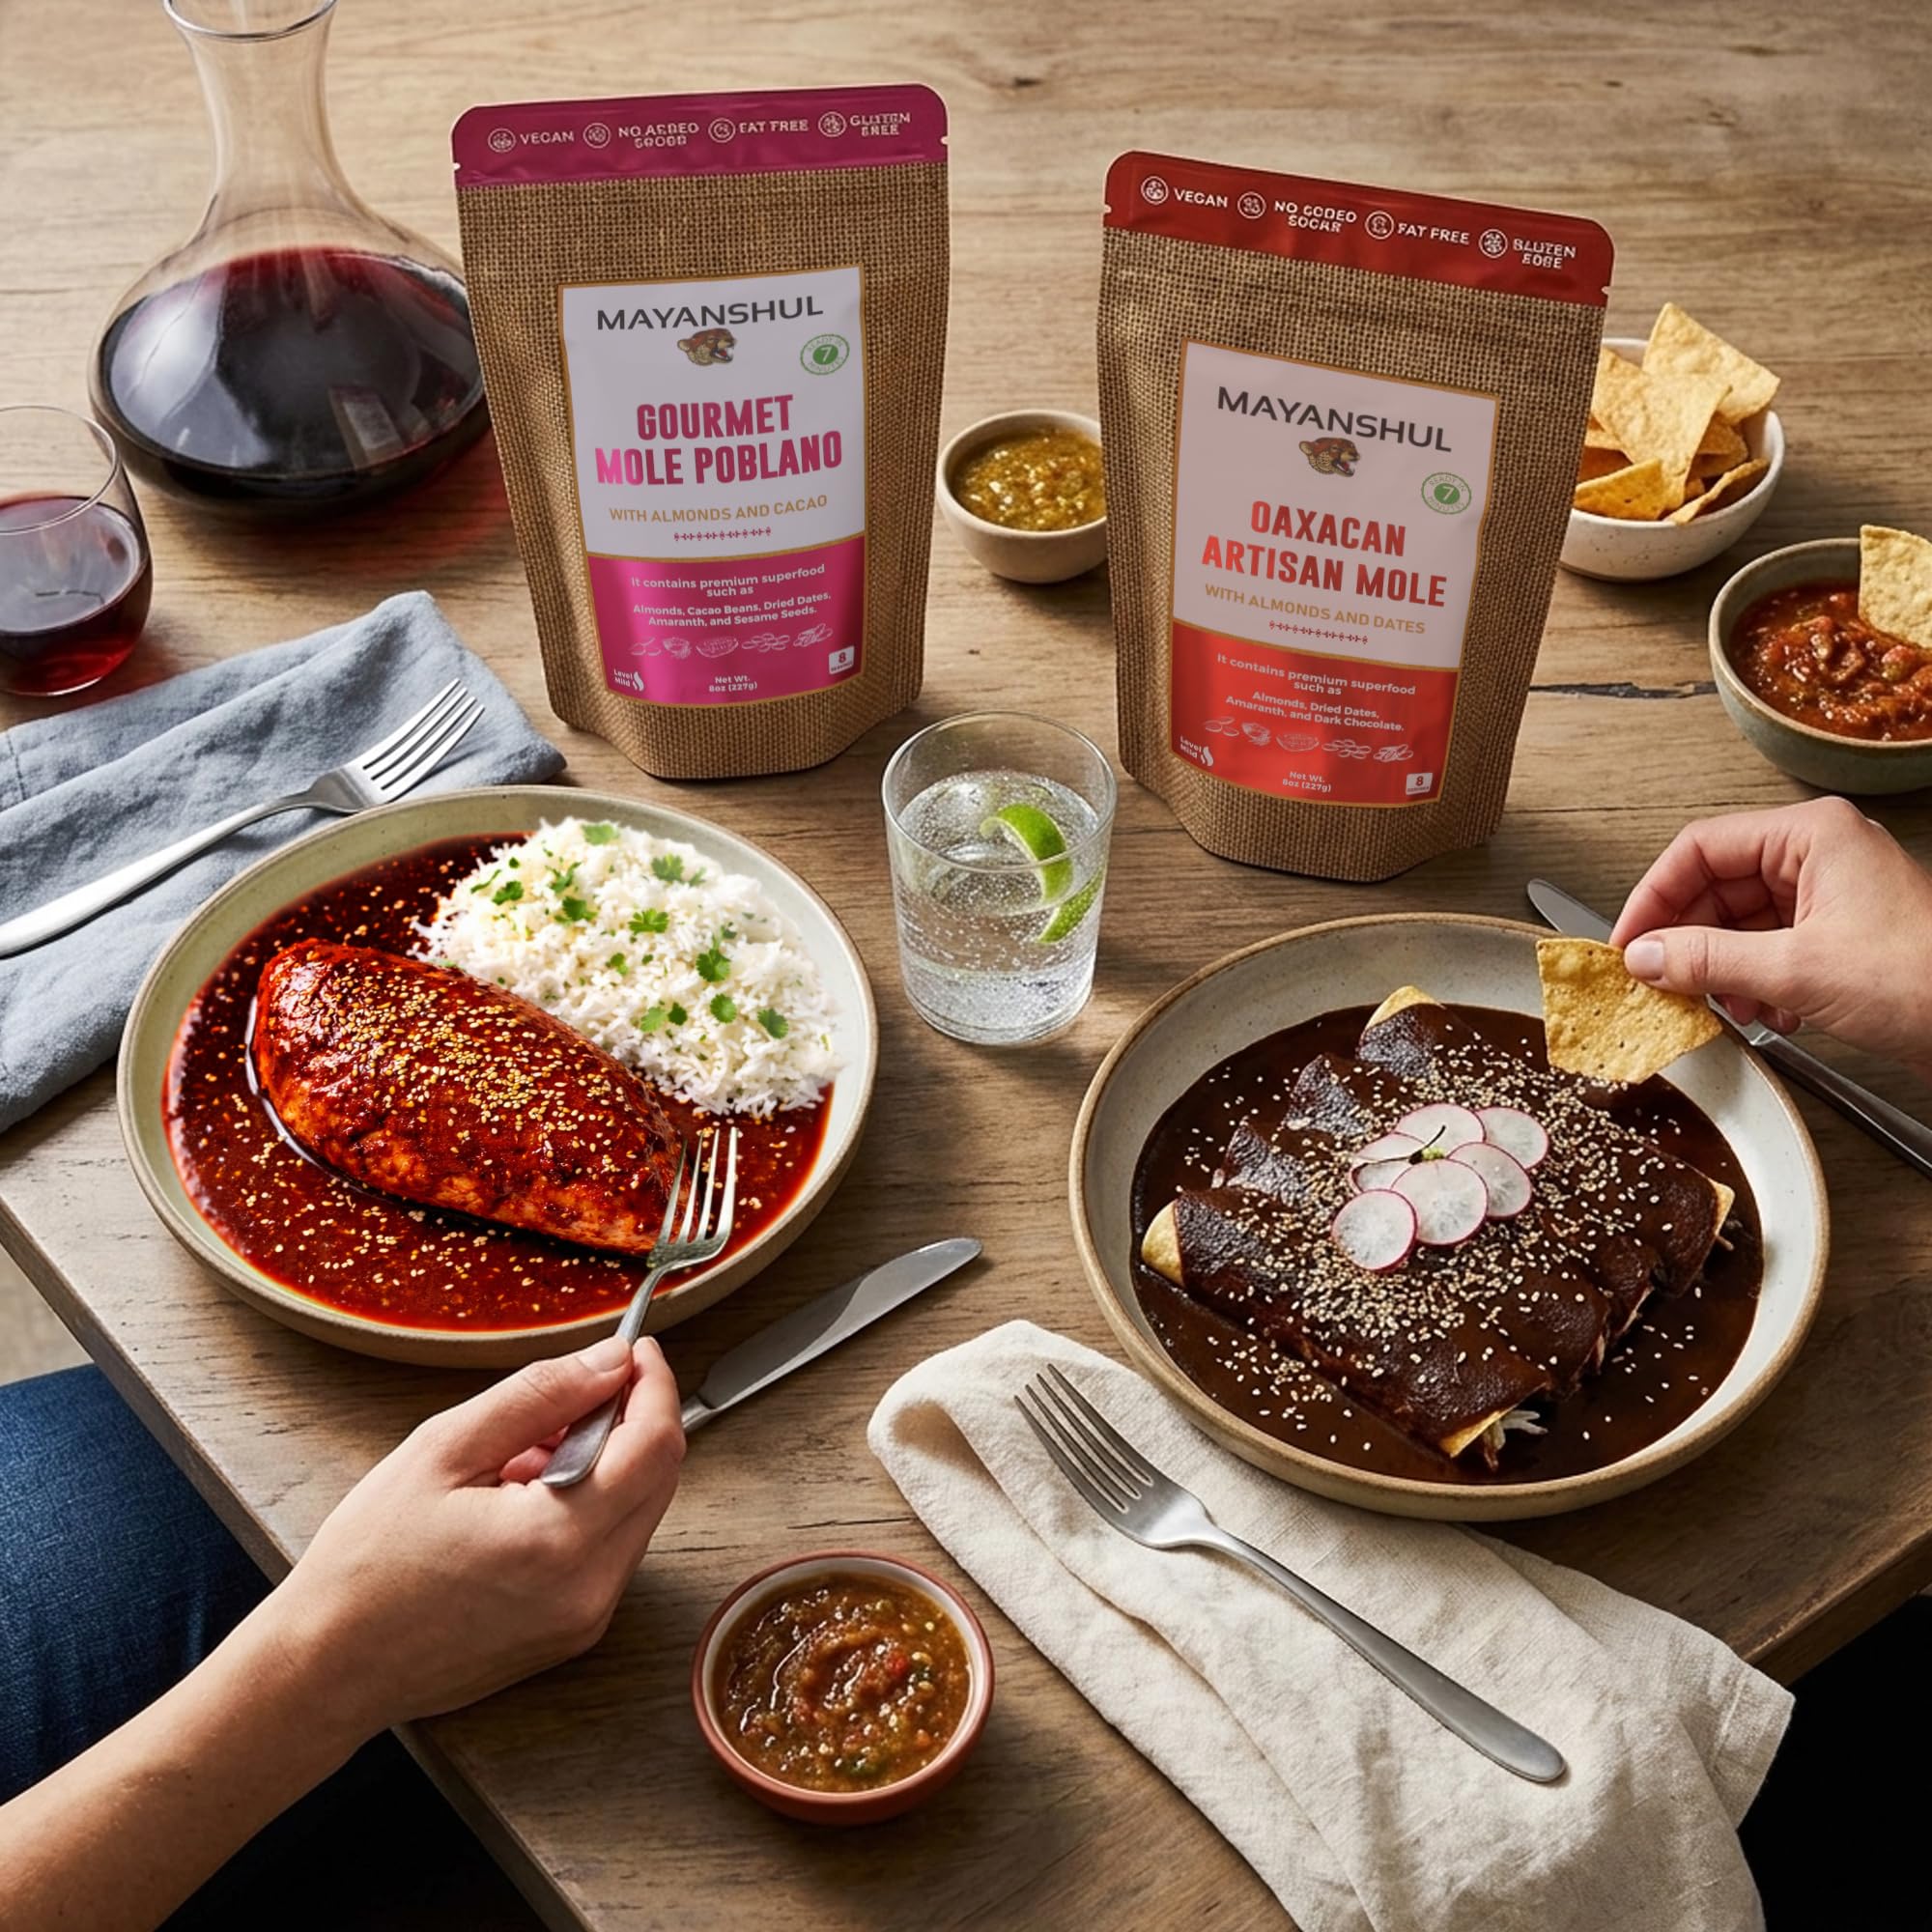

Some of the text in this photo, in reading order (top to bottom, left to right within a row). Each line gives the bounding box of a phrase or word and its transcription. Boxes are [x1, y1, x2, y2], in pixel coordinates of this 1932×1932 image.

[618, 126, 640, 138] NO
[1174, 187, 1229, 208] VEGAN
[1274, 200, 1297, 213] NO
[1397, 222, 1470, 245] FAT FREE
[597, 296, 823, 330] MAYANSHUL
[821, 347, 833, 362] 7
[637, 394, 793, 440] GOURMET
[1217, 385, 1452, 452] MAYANSHUL
[595, 430, 842, 486] MOLE POBLANO
[1442, 486, 1455, 500] 7
[609, 495, 828, 523] WITH ALMONDS AND CACAO
[1251, 500, 1406, 557] OAXACAN
[643, 578, 696, 589] contains
[699, 576, 758, 590] premium
[762, 564, 825, 584] superfood
[1201, 534, 1447, 608] ARTISAN MOLE
[706, 586, 753, 597] such as
[687, 606, 722, 615] Cacao
[764, 598, 794, 611] Dried
[1205, 583, 1426, 635] WITH ALMONDS AND DATES
[710, 616, 731, 626] and
[734, 612, 778, 624] Sesame
[838, 652, 846, 664] 8
[613, 668, 633, 680] Level
[734, 675, 751, 684] Wt.
[1217, 653, 1416, 696] It contains premium superfood
[728, 682, 757, 693] (227g)
[1293, 680, 1342, 696] such as
[1310, 701, 1342, 715] Dried
[1290, 709, 1312, 721] and
[1314, 713, 1342, 725] Dark
[1179, 735, 1202, 753] Level
[1290, 771, 1325, 783] Net Wt.
[1416, 776, 1424, 786] 8
[1301, 781, 1331, 793] (227g)
